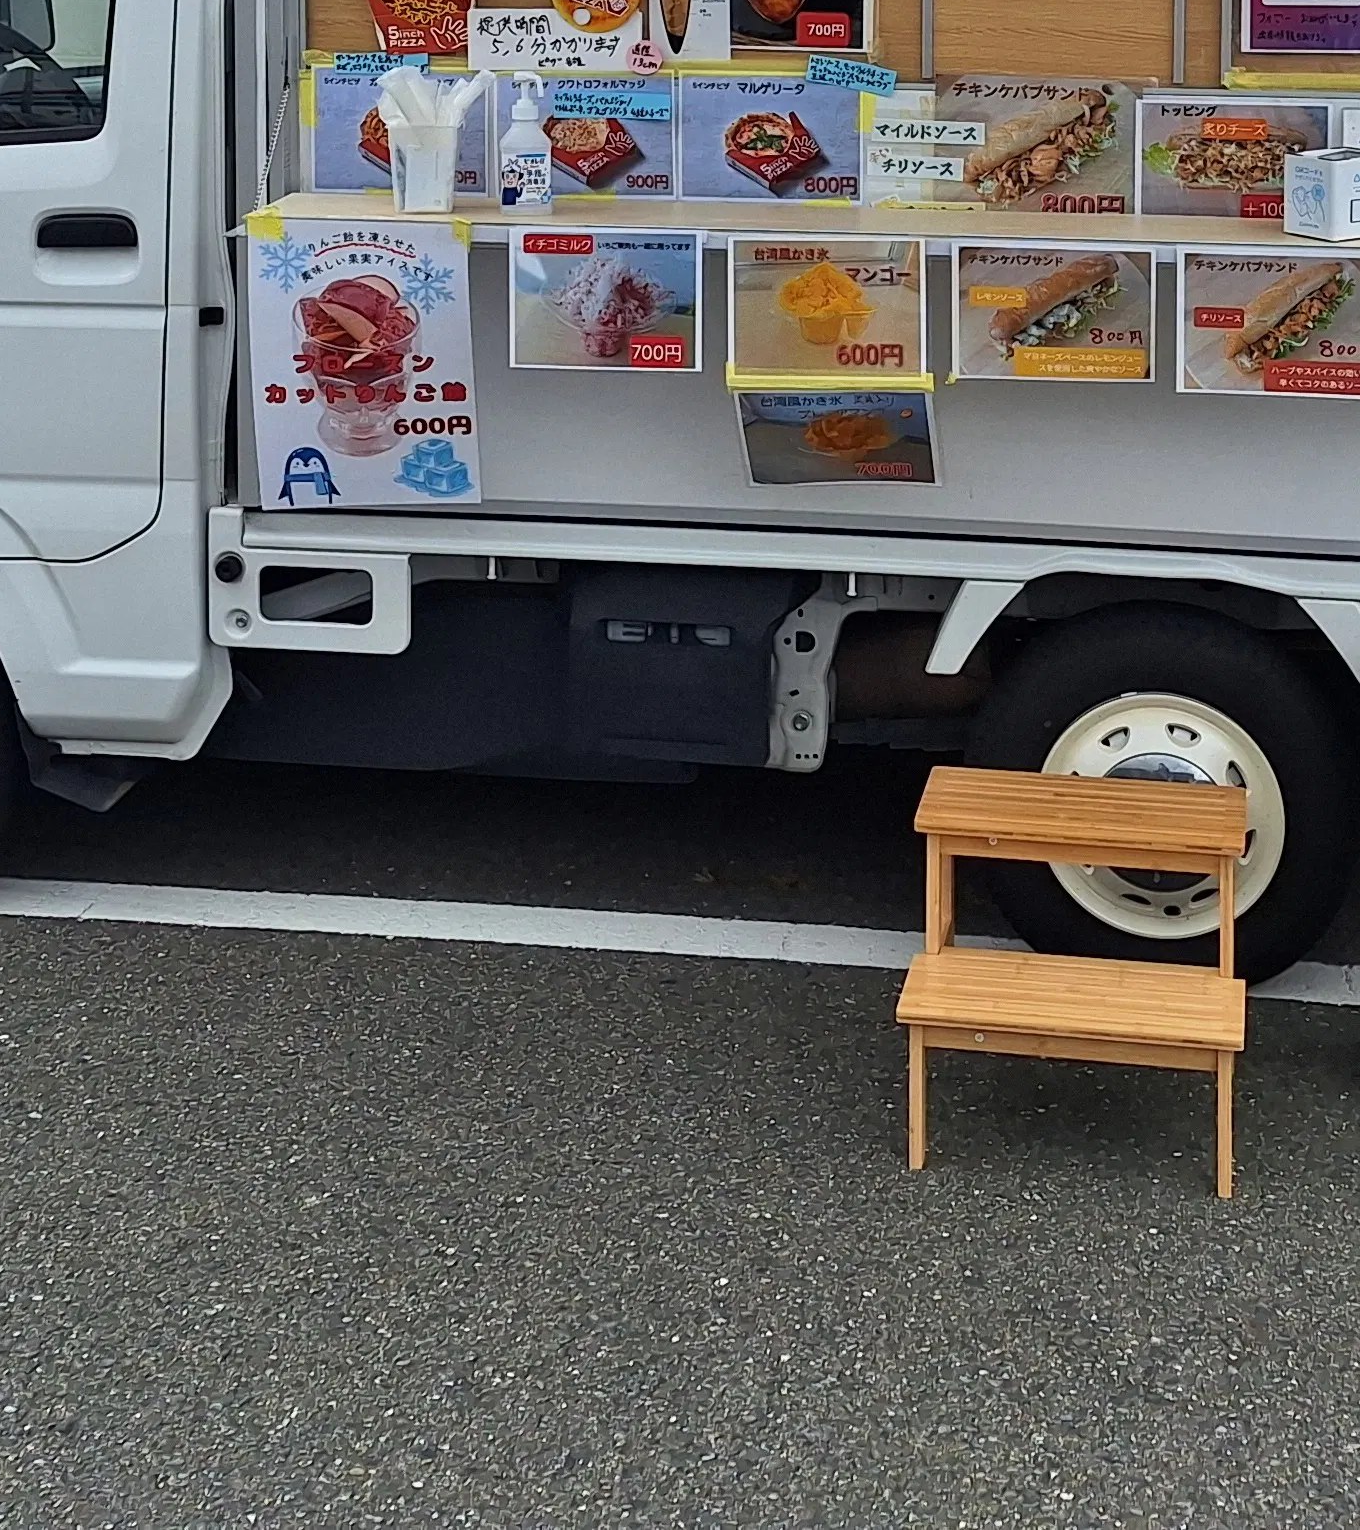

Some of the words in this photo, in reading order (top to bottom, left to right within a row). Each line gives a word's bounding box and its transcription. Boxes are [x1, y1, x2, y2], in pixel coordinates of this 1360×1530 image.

[388, 26, 425, 40] 5inch
[476, 16, 552, 37] 提供時間
[808, 22, 846, 37] 700円
[389, 39, 426, 48] PIZZA
[736, 81, 805, 95] マルゲリータ
[1160, 104, 1217, 118] トッピング
[875, 123, 977, 141] マイルドソース
[1202, 123, 1267, 138] 炙りチーズ
[882, 160, 954, 176] チリソース
[627, 175, 668, 189] 900円
[804, 177, 858, 195] 800円
[1041, 192, 1125, 214] 800円
[525, 237, 593, 251] イチゴミルク
[753, 247, 830, 261] 台湾風かき氷
[844, 267, 911, 286] マンゴー
[976, 292, 1024, 303] レモンソース
[631, 344, 682, 362] 700円
[836, 344, 904, 367] 600円
[393, 415, 472, 436] 600円
[854, 461, 913, 478] 700円
